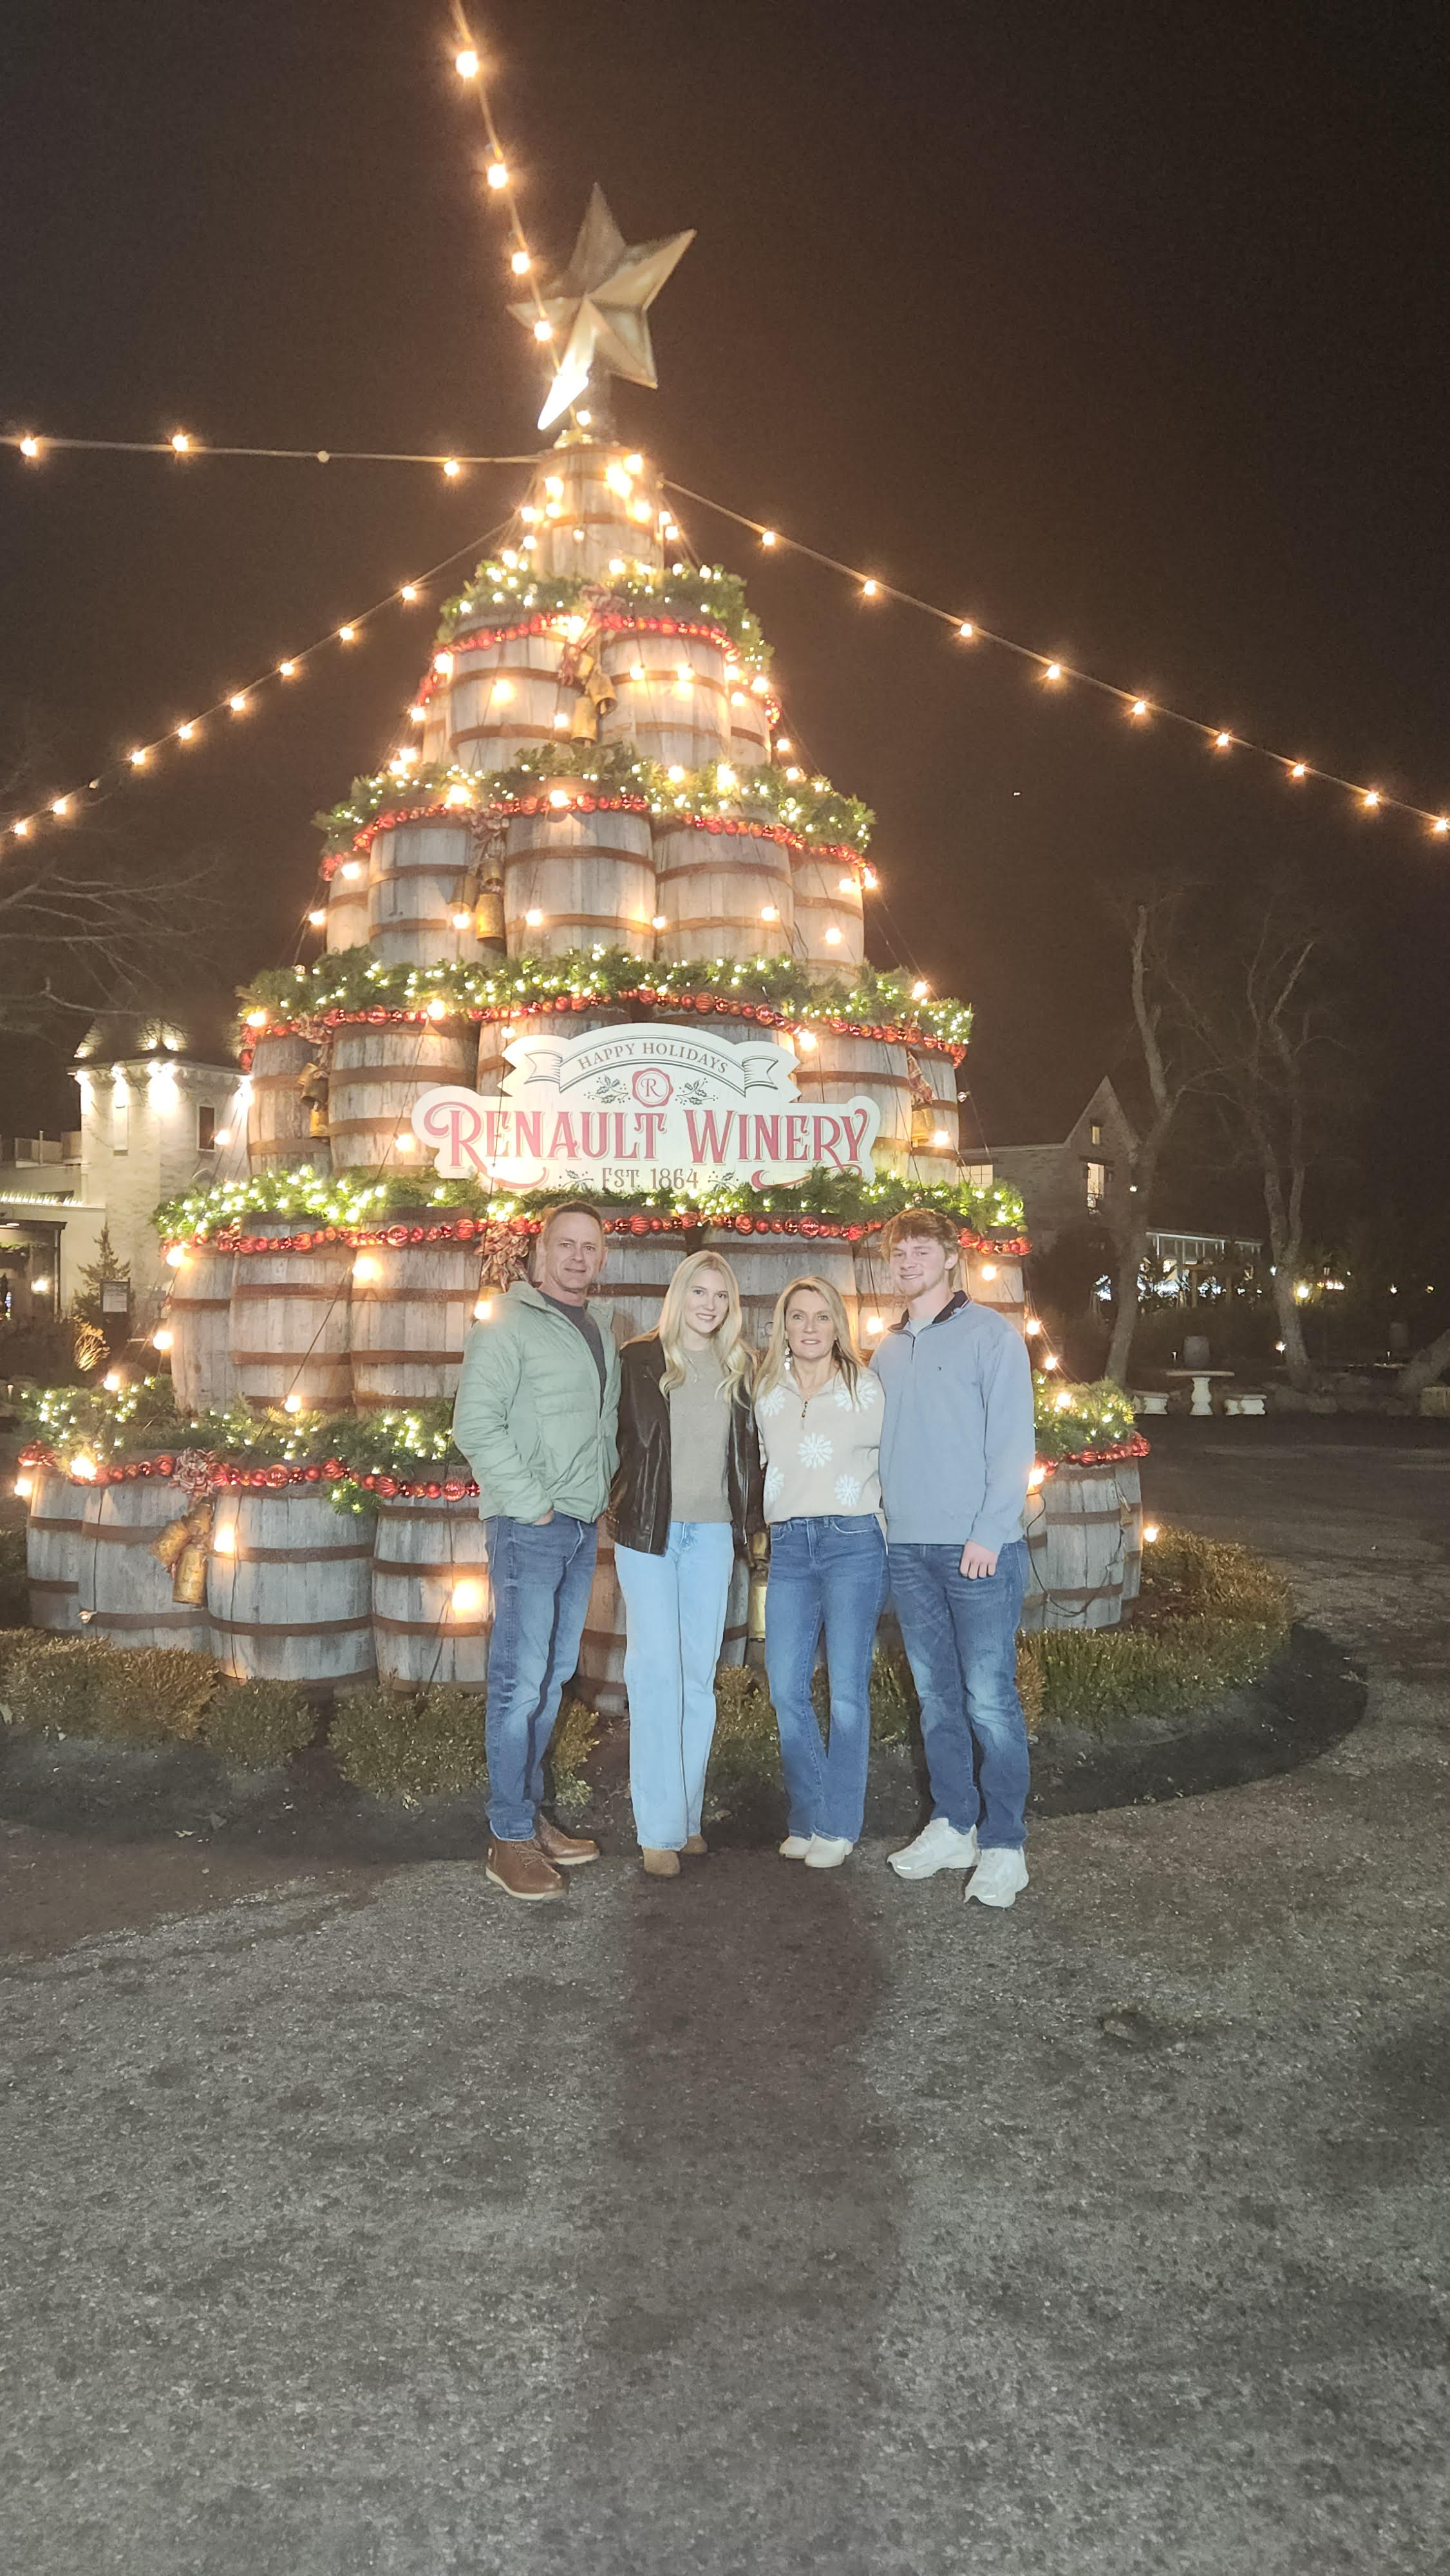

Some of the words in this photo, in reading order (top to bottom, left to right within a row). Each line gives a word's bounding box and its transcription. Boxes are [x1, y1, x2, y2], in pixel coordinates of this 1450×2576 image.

[578, 1043, 636, 1070] HAPPY
[643, 1043, 729, 1074] HOLIDAYS
[641, 1078, 663, 1097] R
[424, 1101, 665, 1189] RENAULT
[683, 1108, 868, 1190] WINERY
[650, 1168, 699, 1190] 1864
